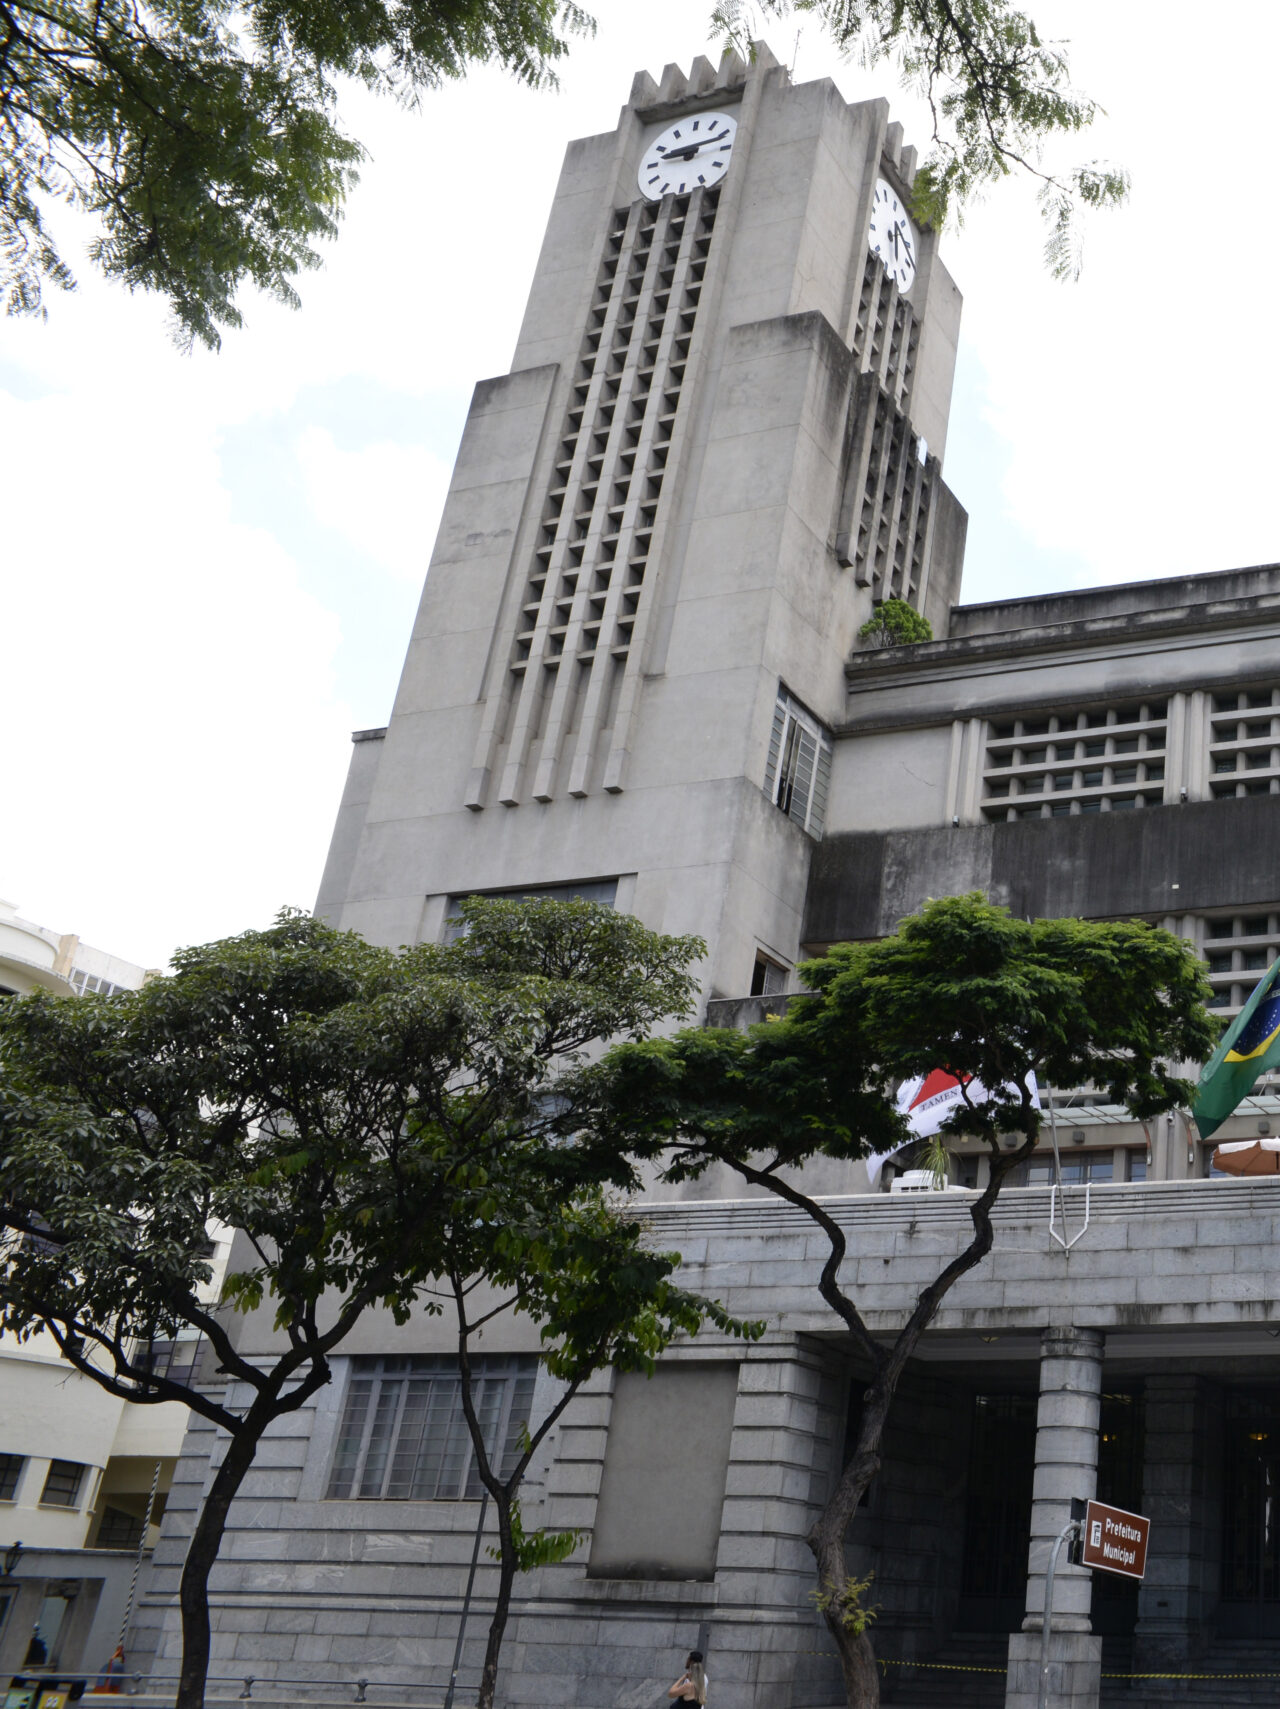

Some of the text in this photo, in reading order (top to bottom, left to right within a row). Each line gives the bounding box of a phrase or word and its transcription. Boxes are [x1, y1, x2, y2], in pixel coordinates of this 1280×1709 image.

[921, 1089, 958, 1111] TAMEN
[1105, 1518, 1141, 1542] Prefeitura
[1103, 1542, 1136, 1566] Municipal
